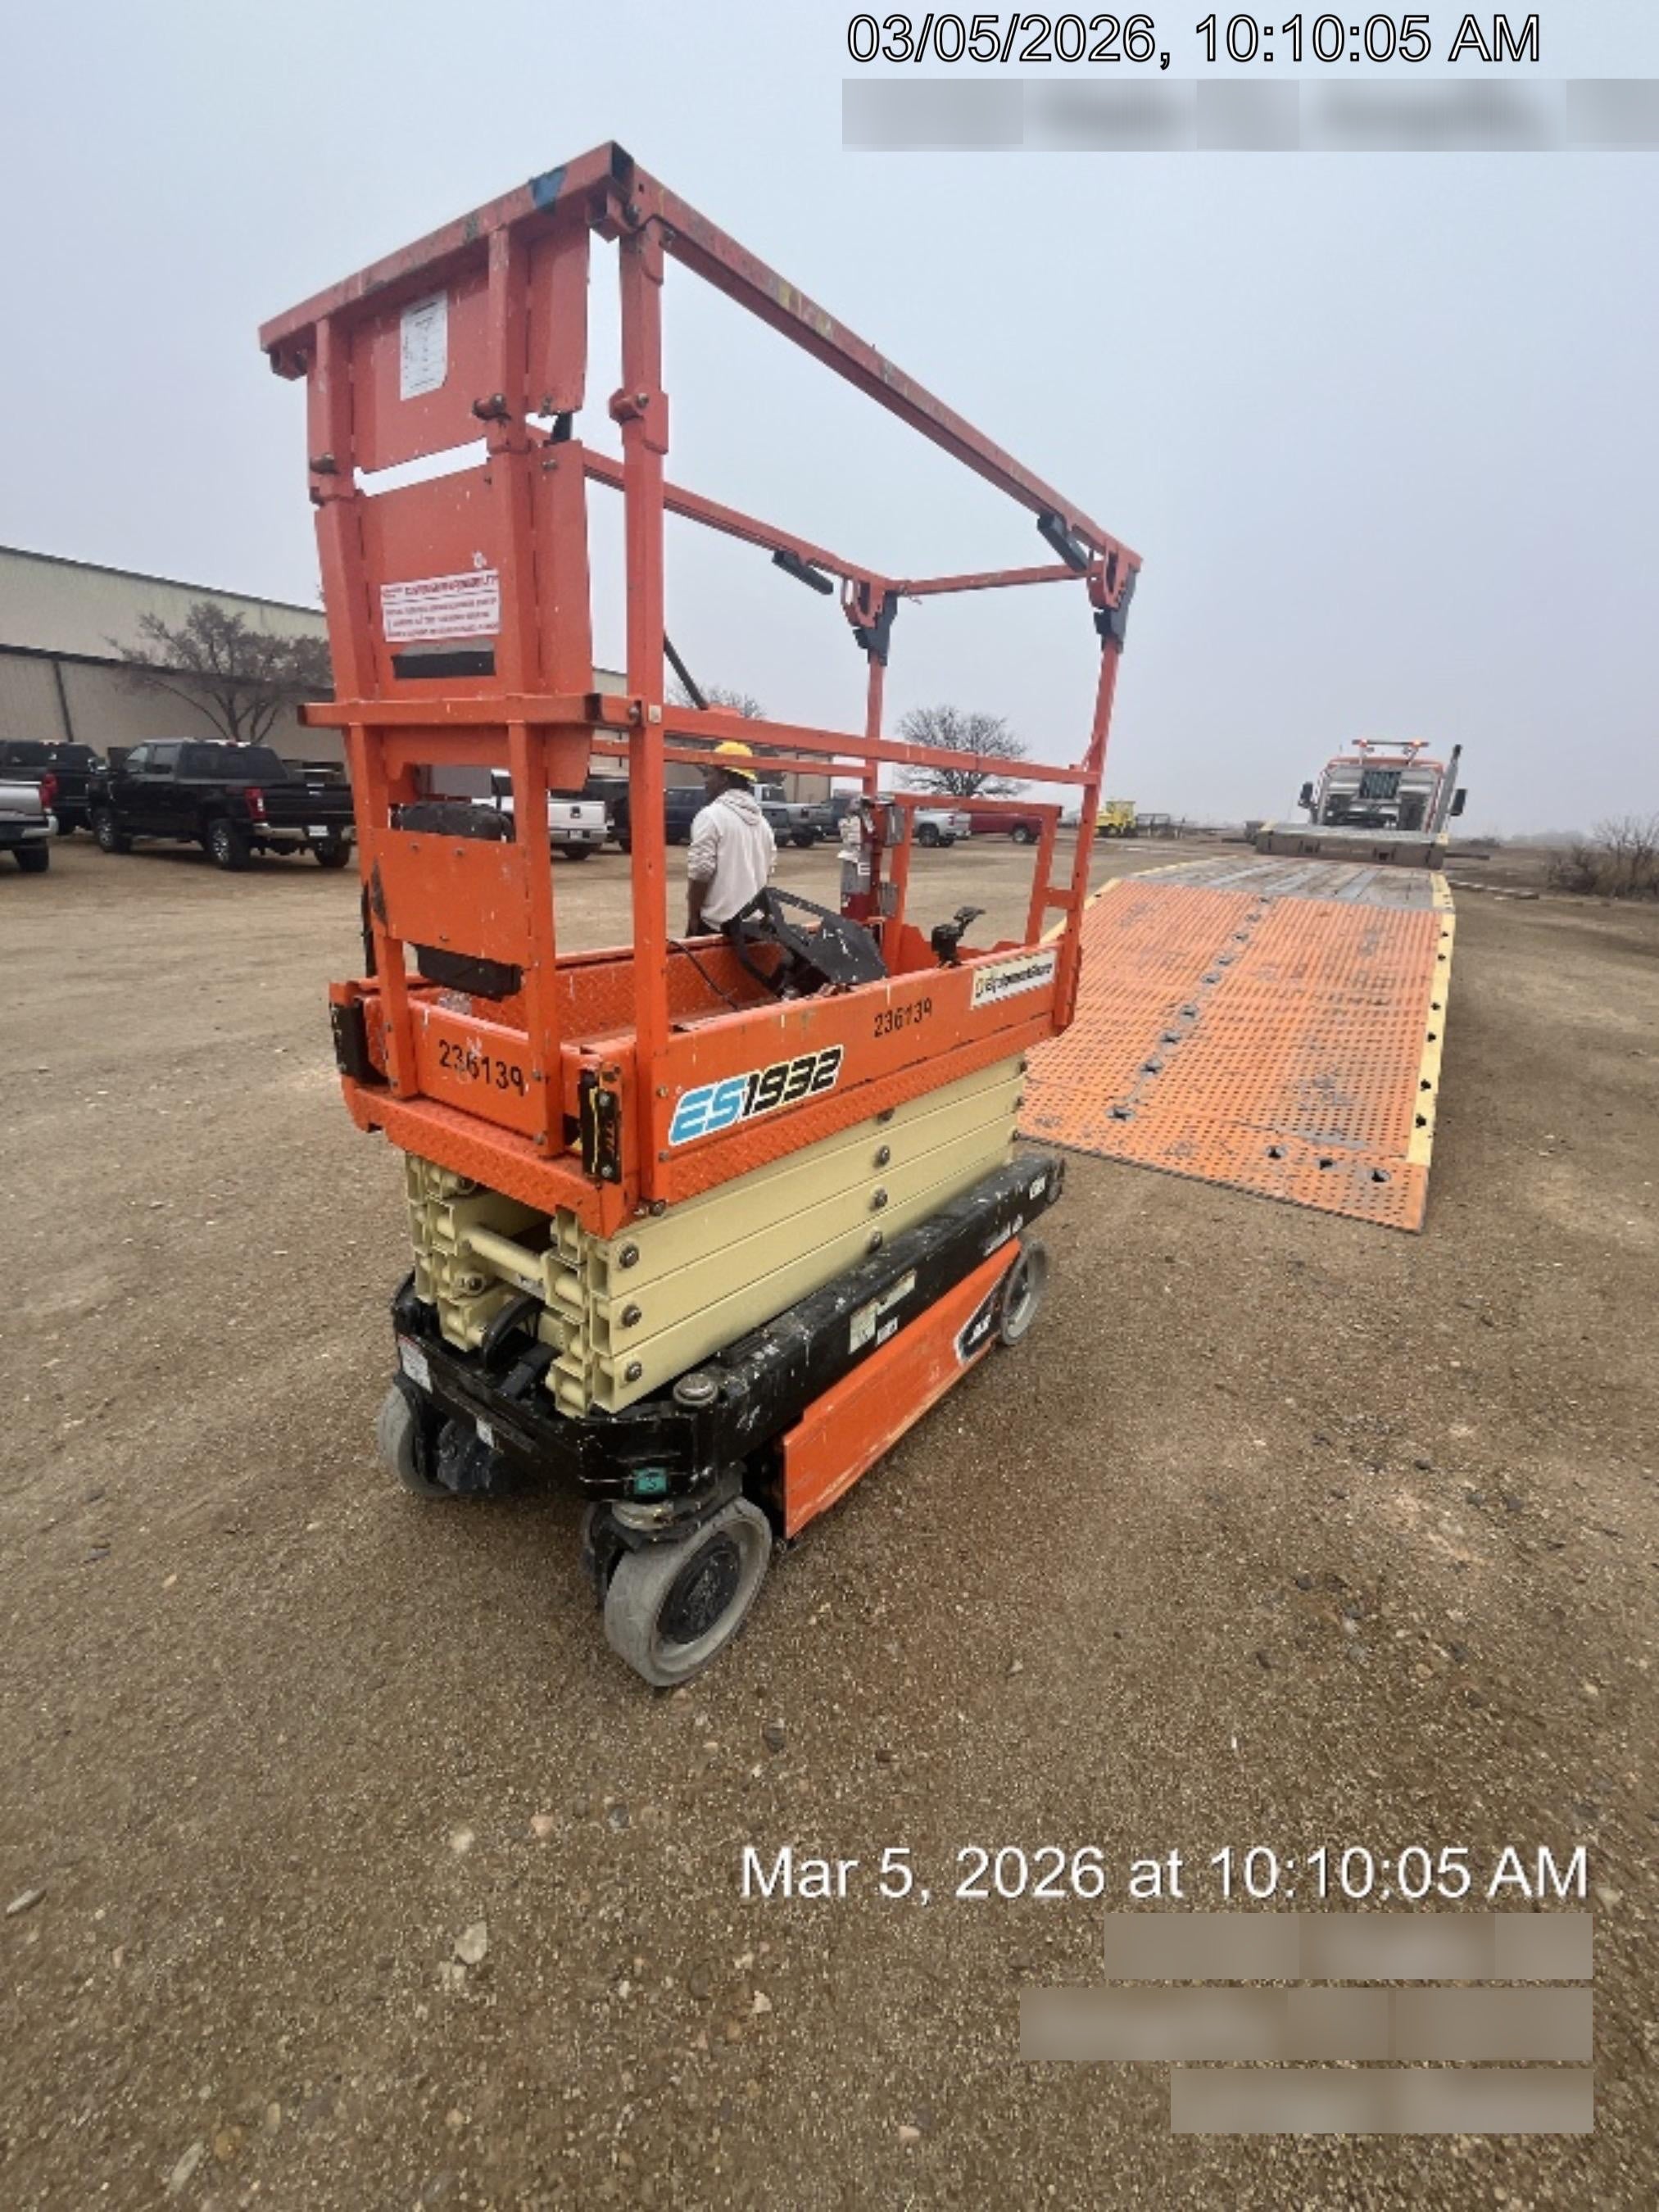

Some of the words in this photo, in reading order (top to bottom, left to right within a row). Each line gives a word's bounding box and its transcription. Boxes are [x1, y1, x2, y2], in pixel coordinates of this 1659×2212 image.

[874, 997, 932, 1038] 236139
[439, 1039, 525, 1097] 236139
[669, 1045, 843, 1145] ES1932
